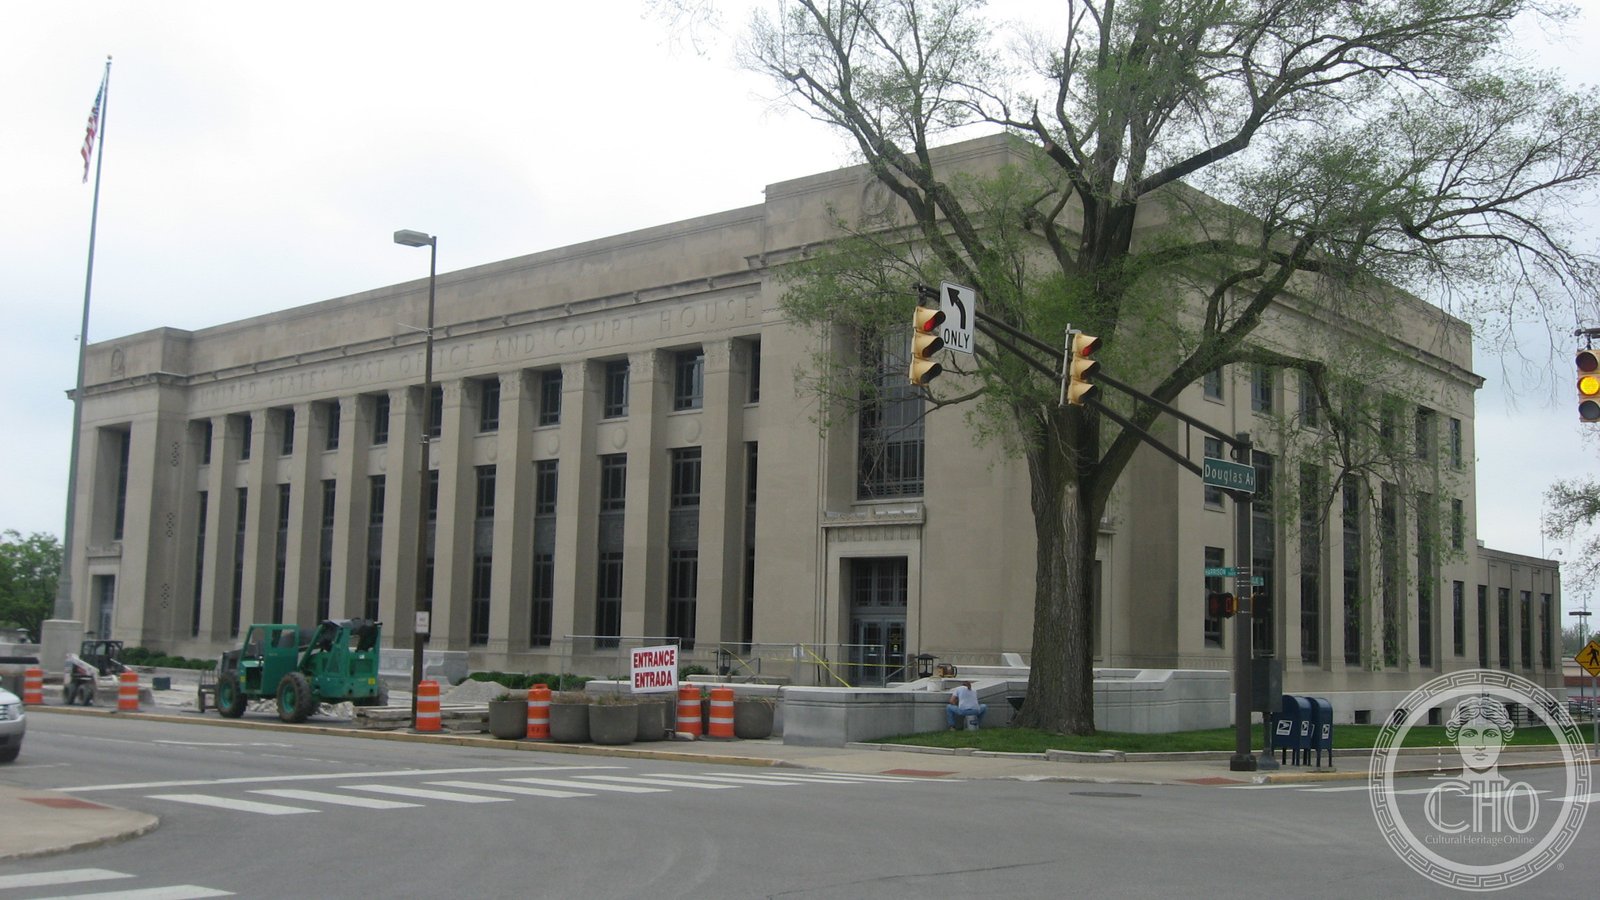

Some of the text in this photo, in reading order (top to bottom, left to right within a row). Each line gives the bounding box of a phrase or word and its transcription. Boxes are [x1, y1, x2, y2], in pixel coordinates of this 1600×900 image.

[944, 328, 970, 349] ONLY
[200, 295, 756, 405] UNITED STATES POST OFICE AND COURT HOUSE
[1204, 463, 1243, 485] Douglas
[633, 650, 675, 669] ENTRANCE
[634, 670, 673, 689] ENTRADA
